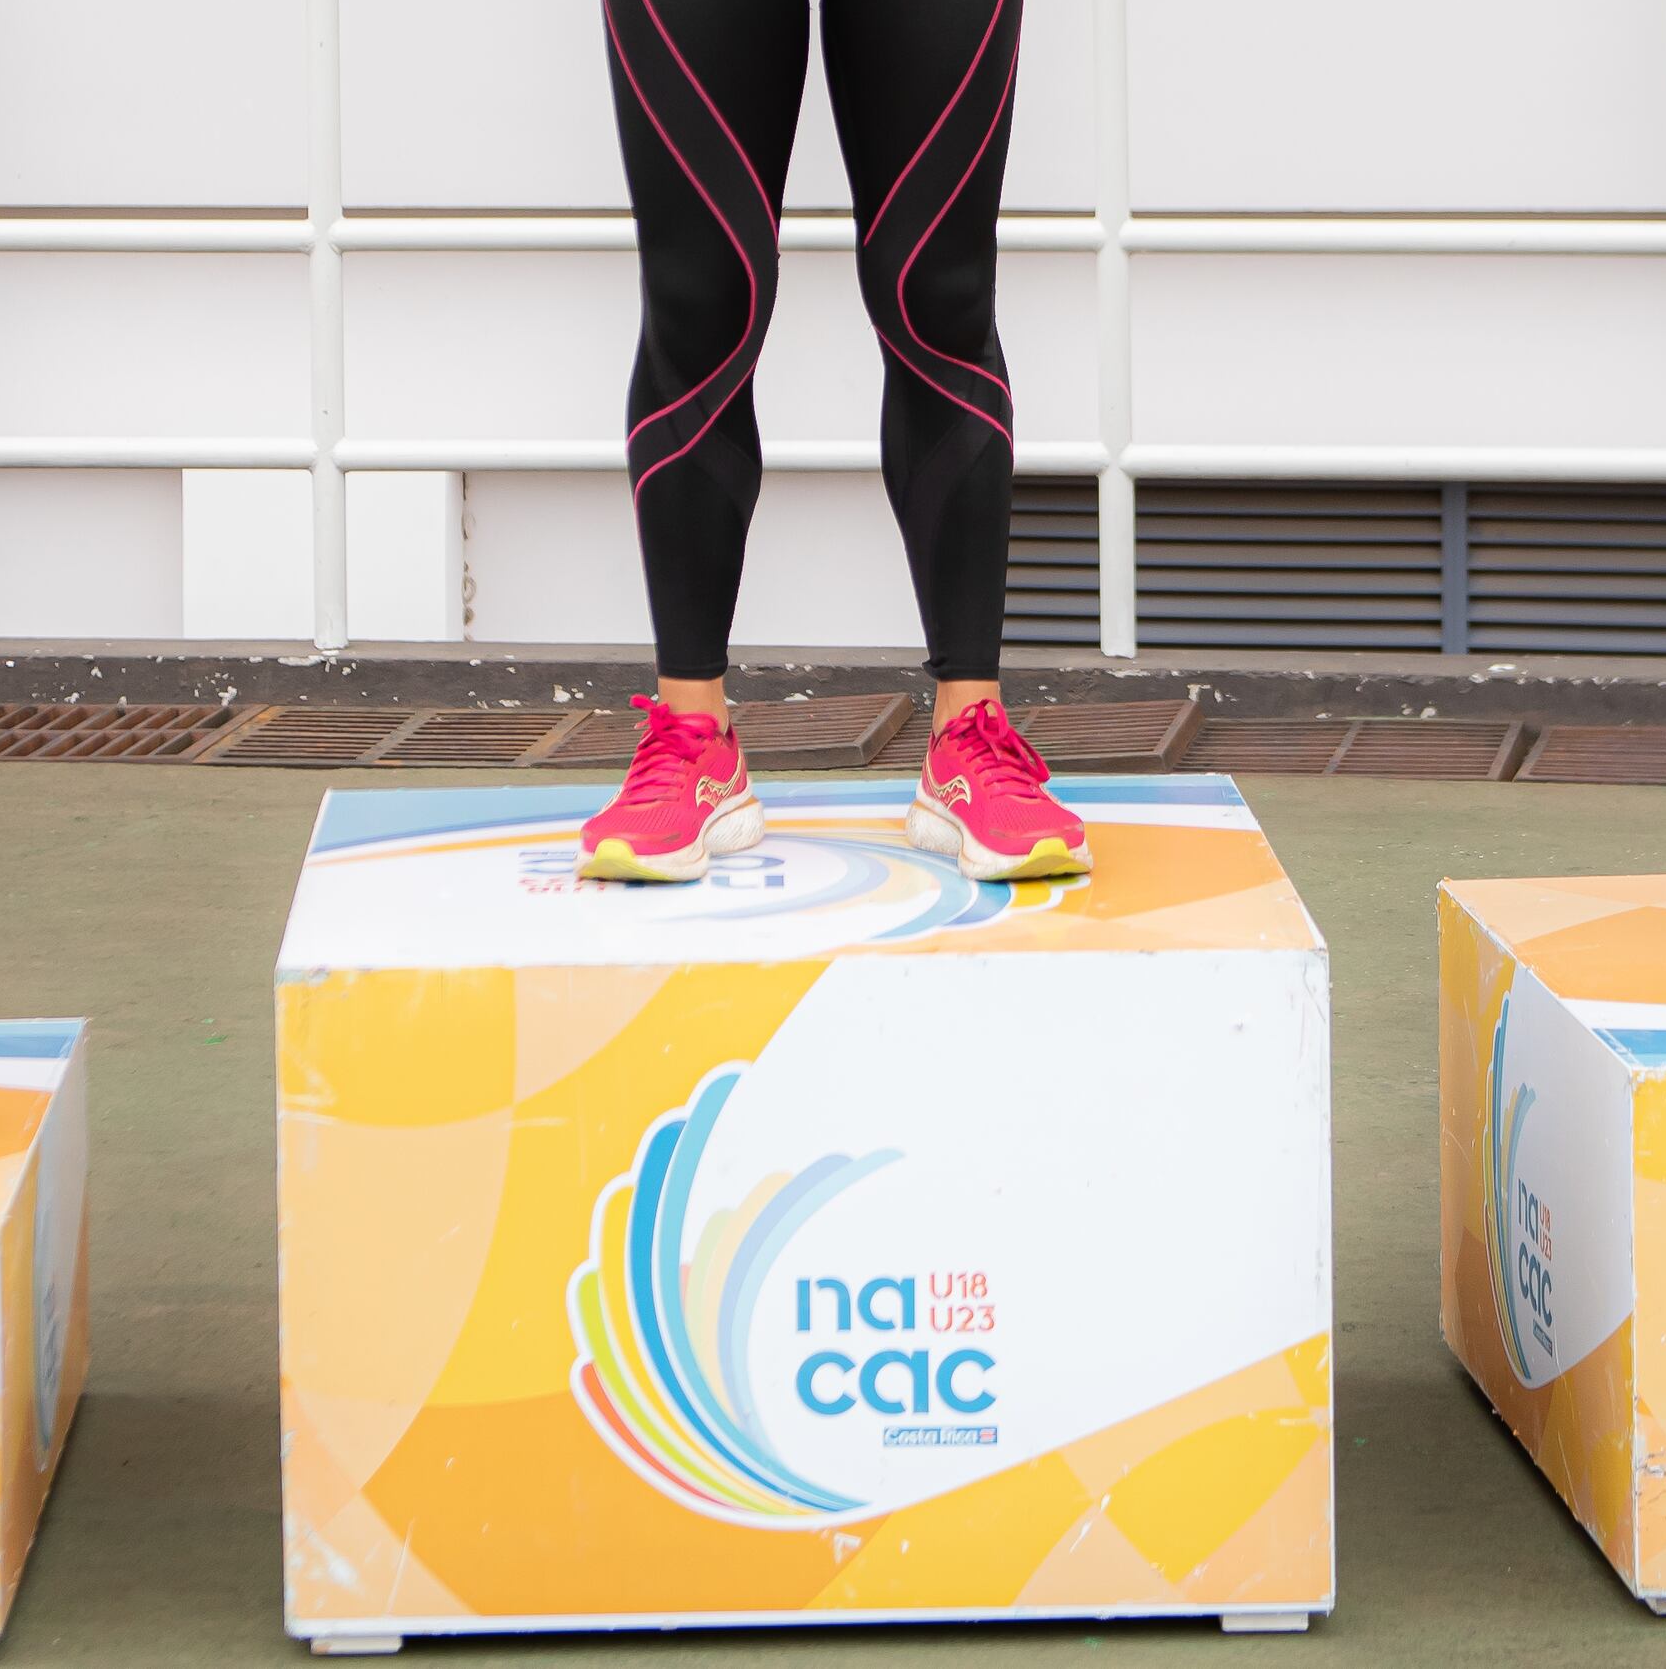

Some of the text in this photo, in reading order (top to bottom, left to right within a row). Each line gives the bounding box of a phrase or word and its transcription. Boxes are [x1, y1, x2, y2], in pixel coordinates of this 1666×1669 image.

[1519, 1178, 1539, 1245] na
[1540, 1200, 1551, 1233] U18
[1540, 1229, 1552, 1261] U23
[796, 1277, 915, 1331] na
[929, 1272, 989, 1299] U18
[1519, 1242, 1552, 1327] cac
[929, 1305, 996, 1332] U23
[796, 1349, 996, 1415] cac
